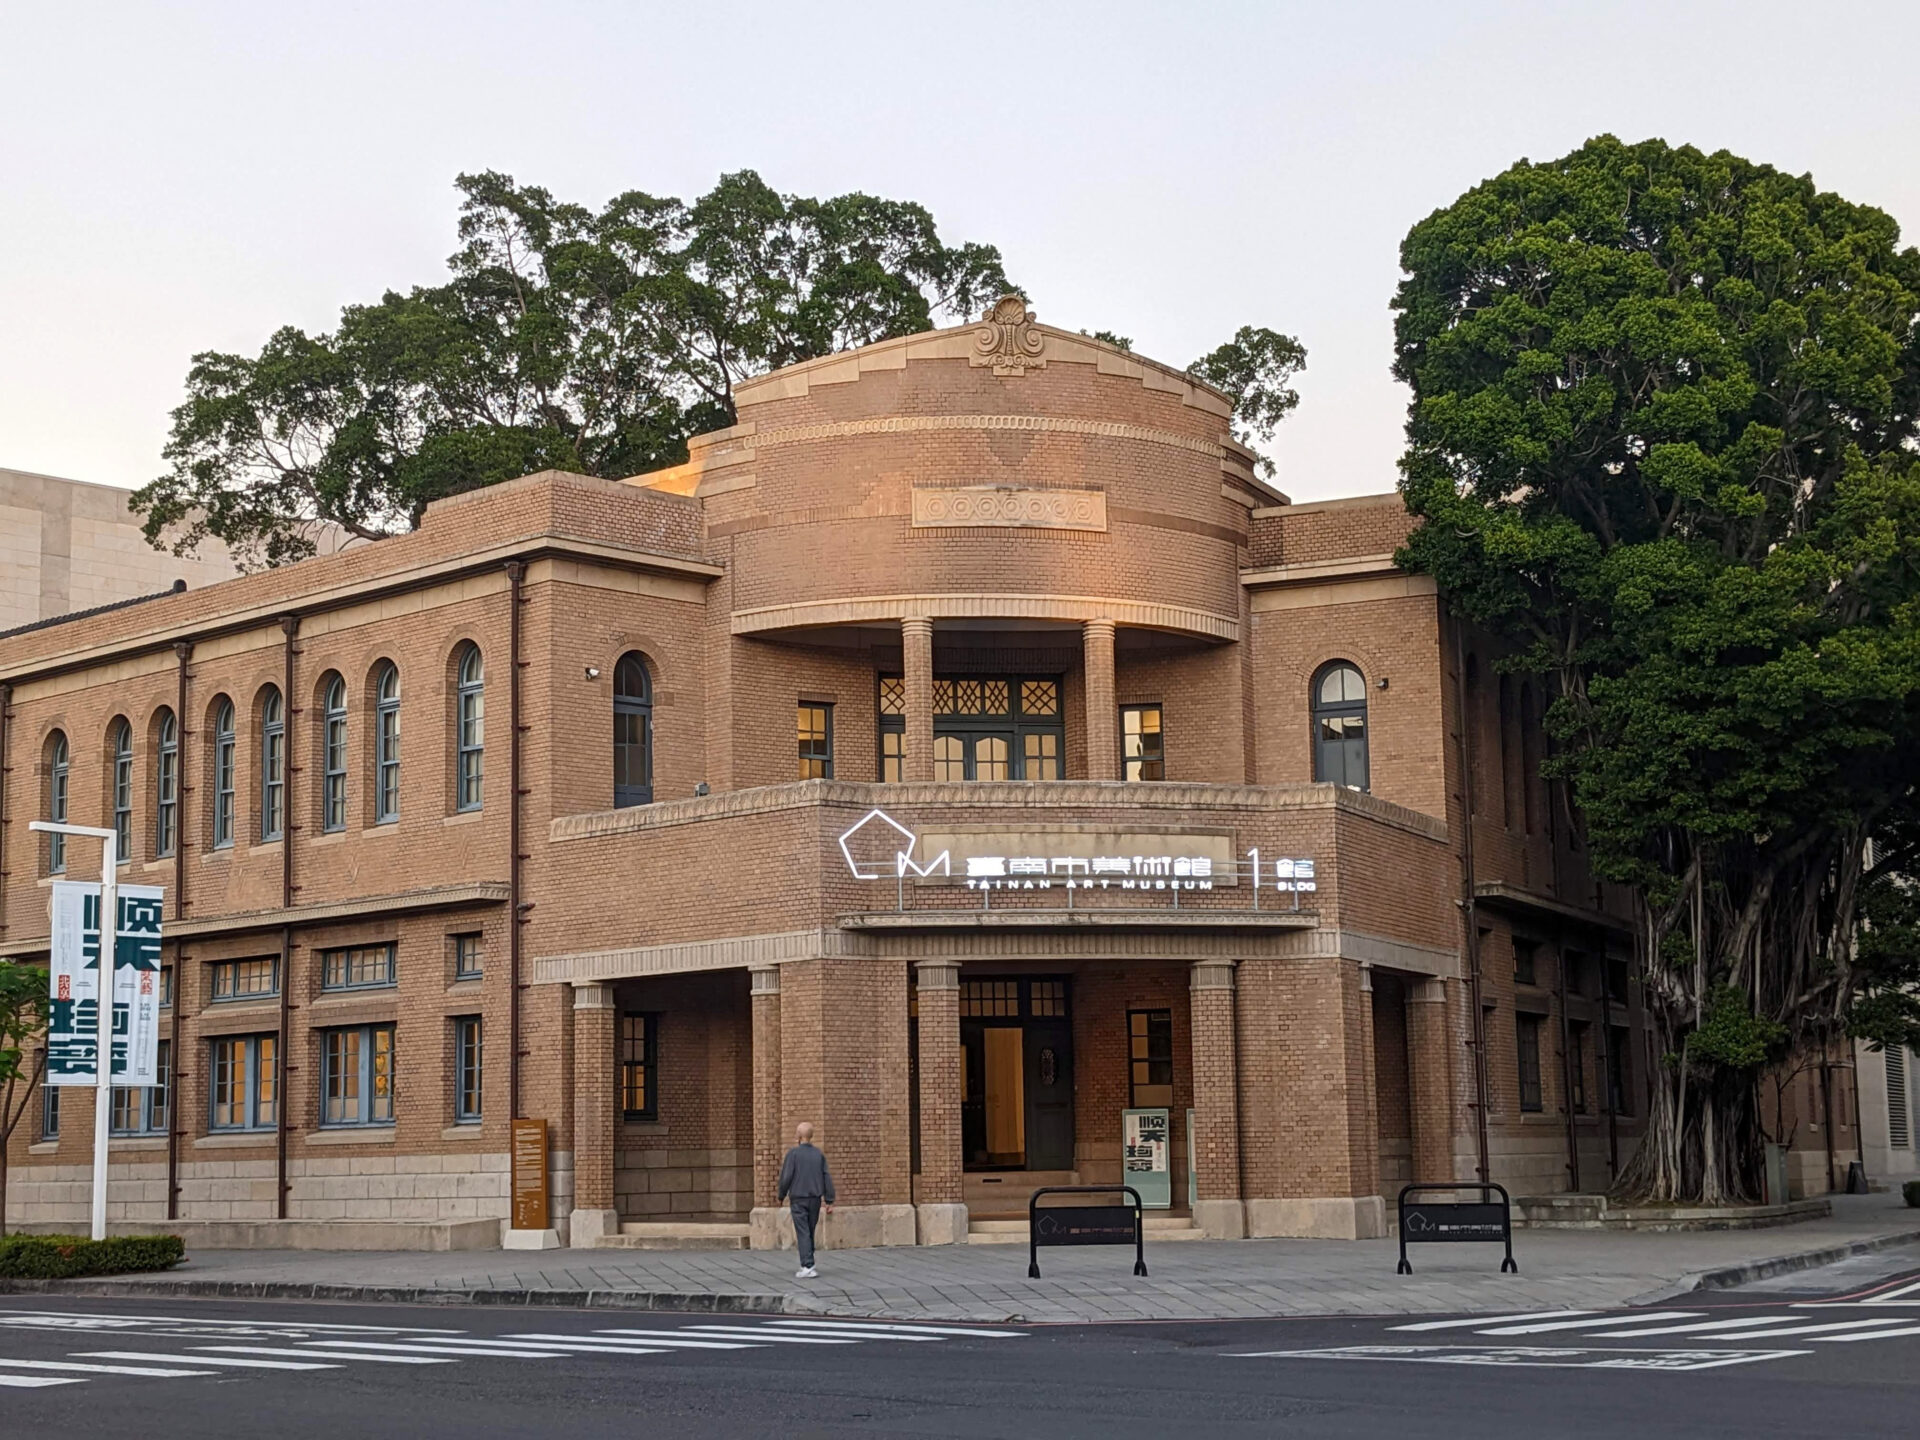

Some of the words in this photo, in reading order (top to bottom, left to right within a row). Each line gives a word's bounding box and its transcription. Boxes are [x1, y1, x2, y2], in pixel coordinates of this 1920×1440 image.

[966, 879, 1051, 890] TAINAN
[1066, 879, 1110, 890] ART
[1122, 879, 1213, 890] MUSEUM
